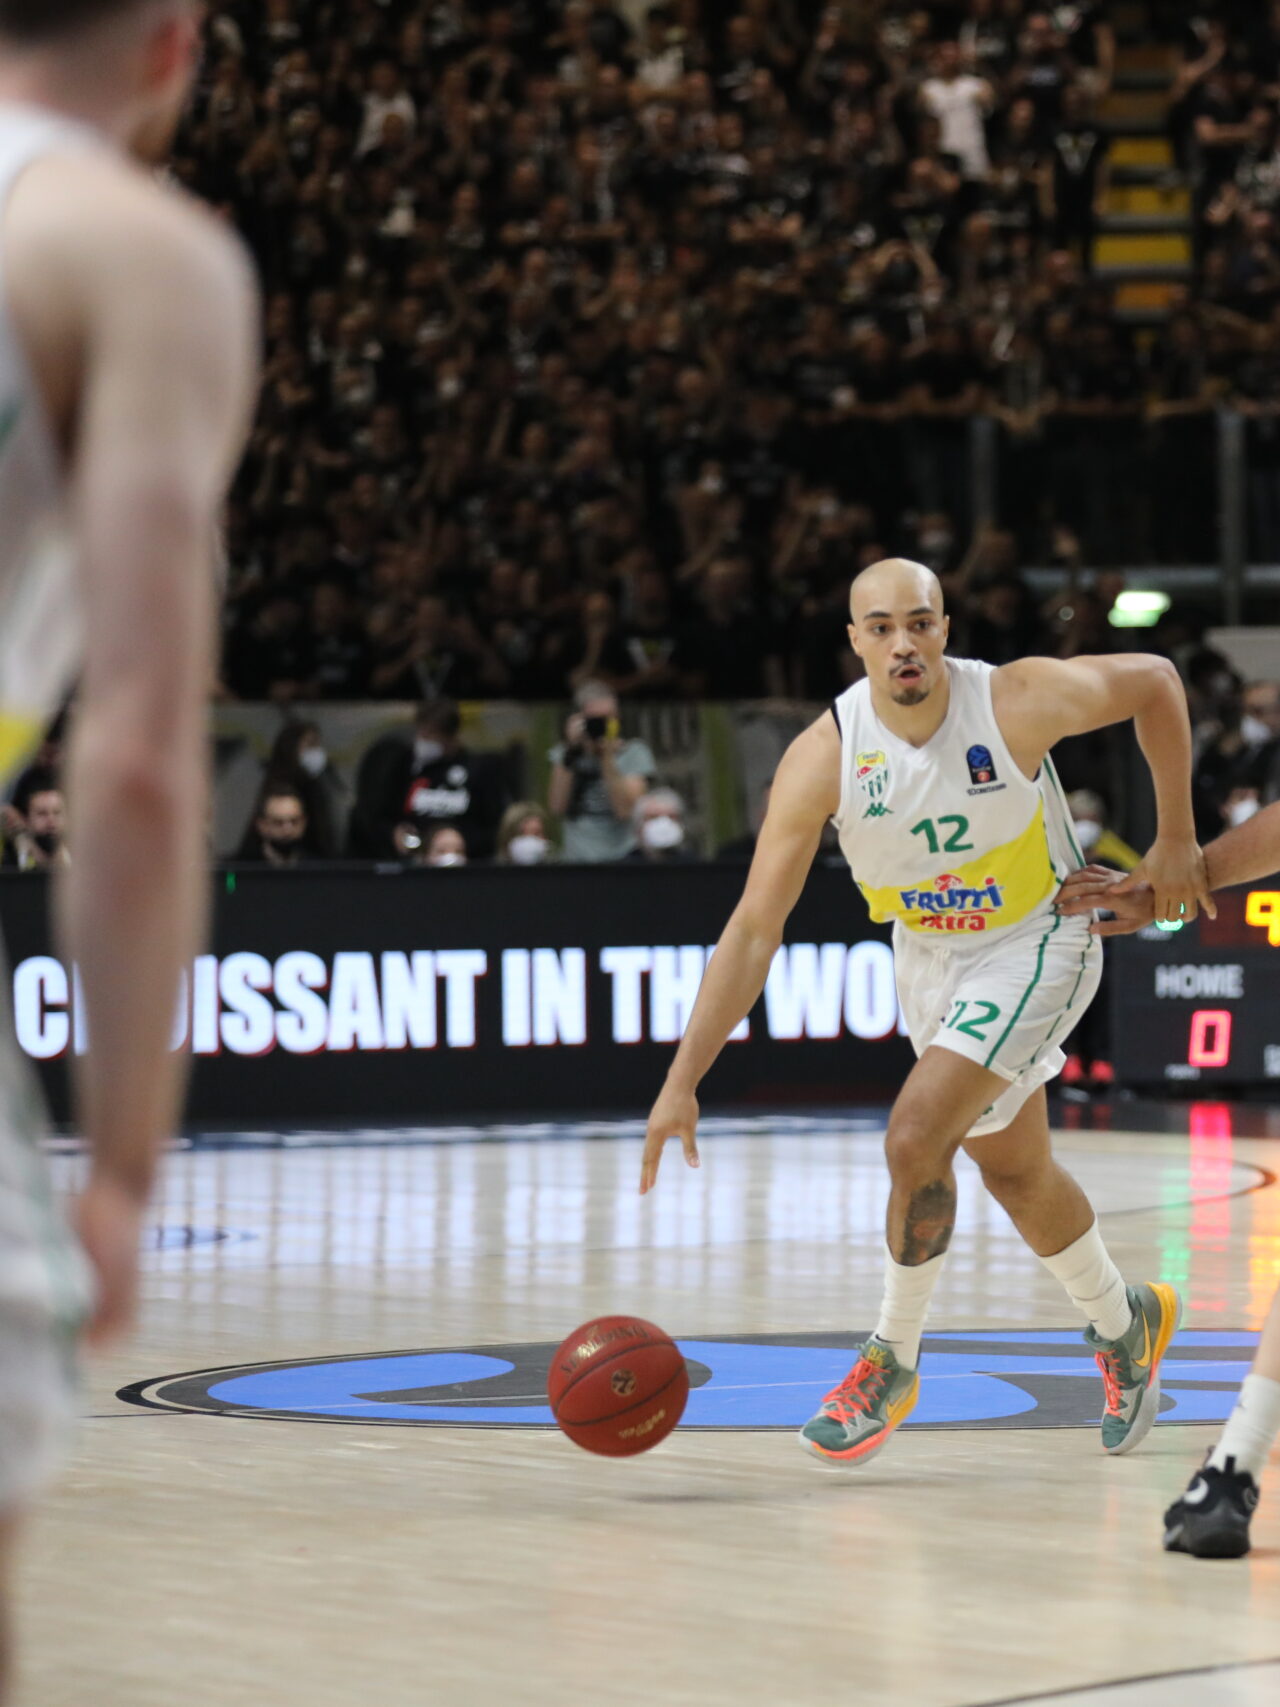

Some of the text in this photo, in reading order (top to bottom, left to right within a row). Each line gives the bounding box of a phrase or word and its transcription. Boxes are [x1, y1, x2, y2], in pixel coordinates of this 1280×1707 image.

[910, 815, 974, 854] 12
[13, 940, 910, 1059] CISSANT IN TH WO
[1155, 965, 1244, 998] HOME
[947, 1000, 1001, 1042] 12
[1188, 1010, 1232, 1067] 0
